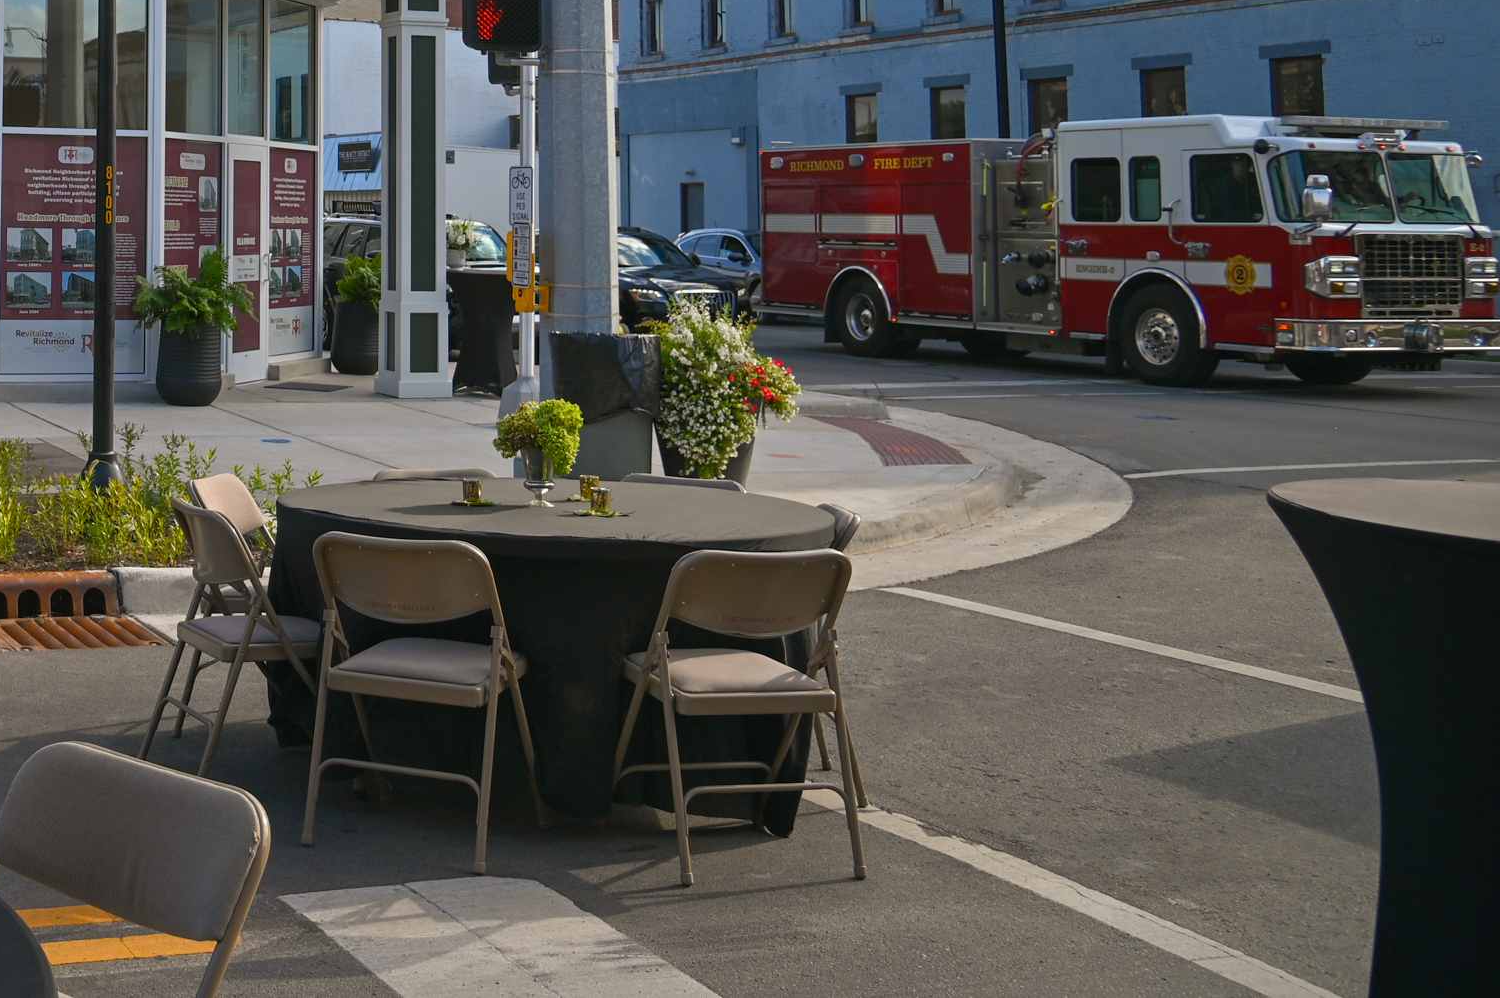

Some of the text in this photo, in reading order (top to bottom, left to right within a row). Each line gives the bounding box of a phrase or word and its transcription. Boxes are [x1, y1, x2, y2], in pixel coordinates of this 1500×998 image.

[790, 156, 933, 172] RICHMOND FIRE DEPT
[516, 192, 526, 200] USE
[516, 202, 526, 210] PED
[17, 212, 58, 222] Readmore
[59, 214, 91, 224] Through
[512, 213, 530, 221] SIGNAL
[1470, 243, 1485, 252] E-2
[1075, 264, 1115, 274] ENGINE-2
[1236, 268, 1244, 280] 2
[365, 600, 392, 609] EARLHAM
